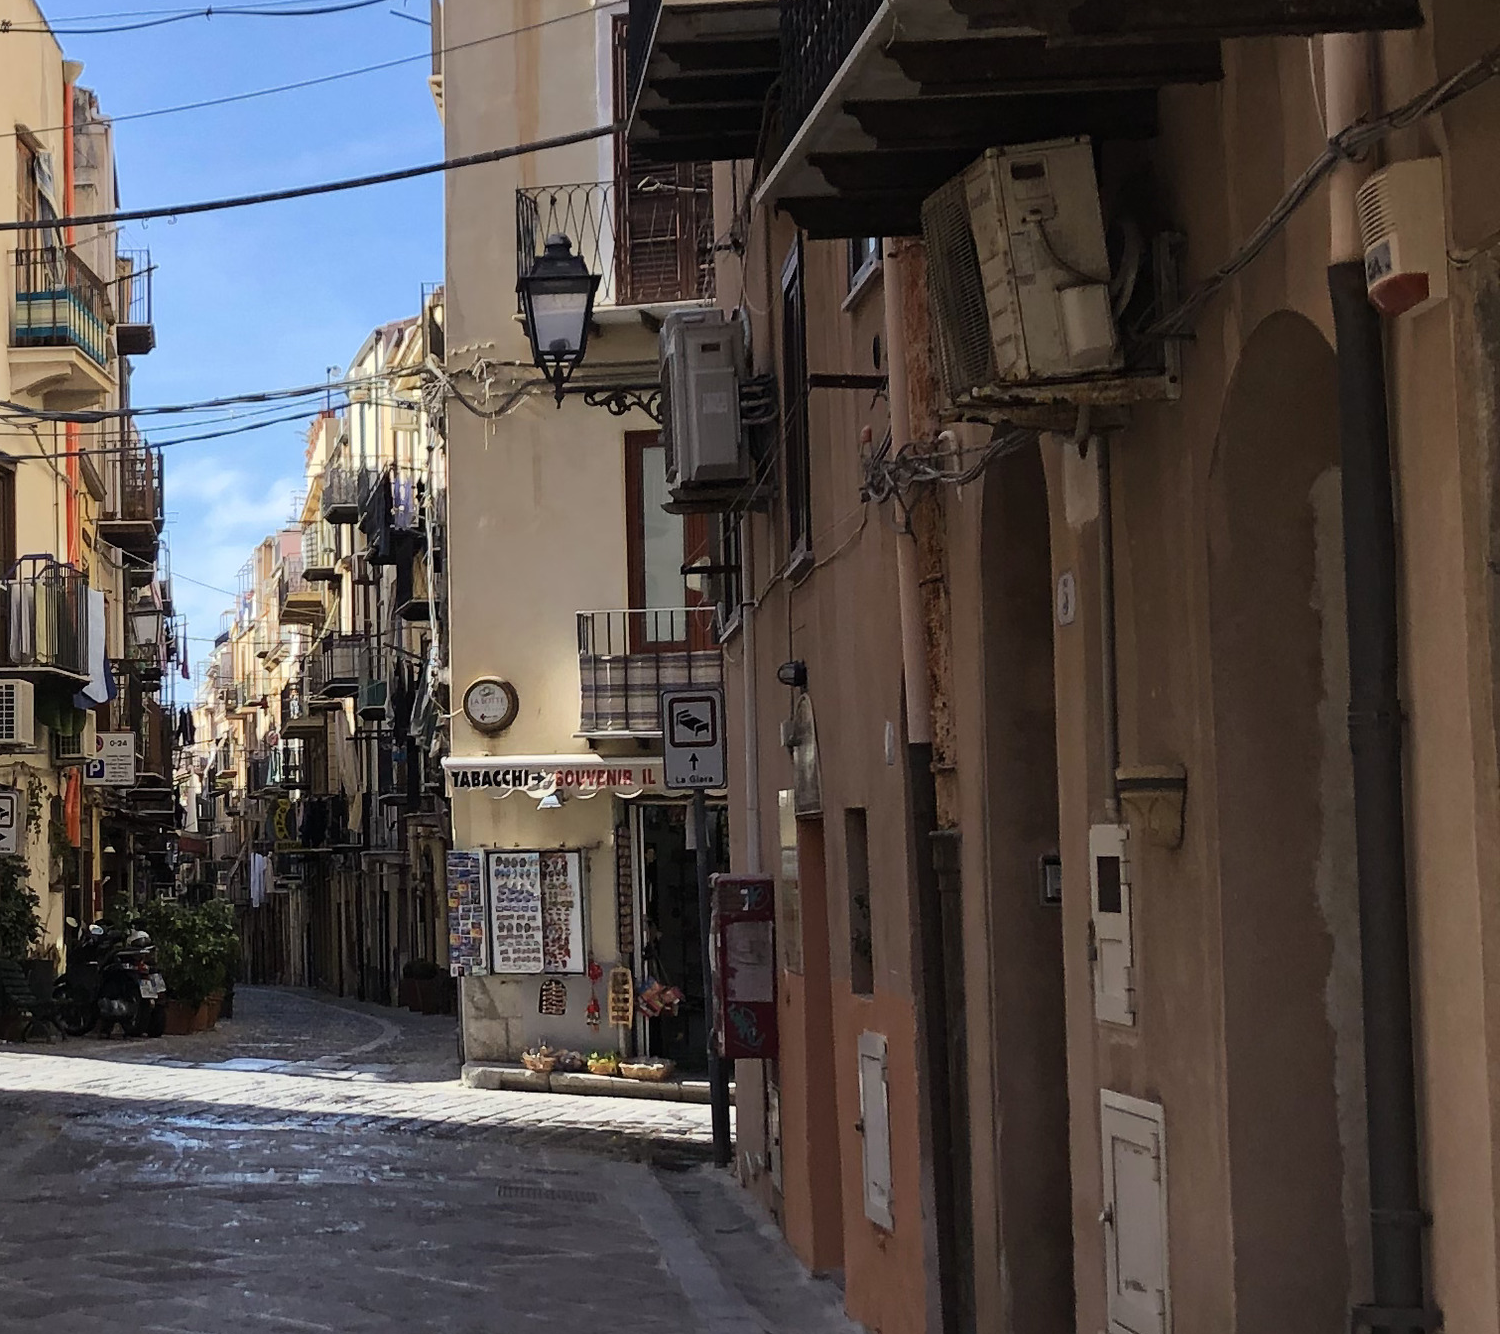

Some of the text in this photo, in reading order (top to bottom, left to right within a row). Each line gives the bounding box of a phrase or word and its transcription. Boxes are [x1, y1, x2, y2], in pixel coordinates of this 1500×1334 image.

[451, 768, 656, 787] TABACCHI SOUVENIR IL
